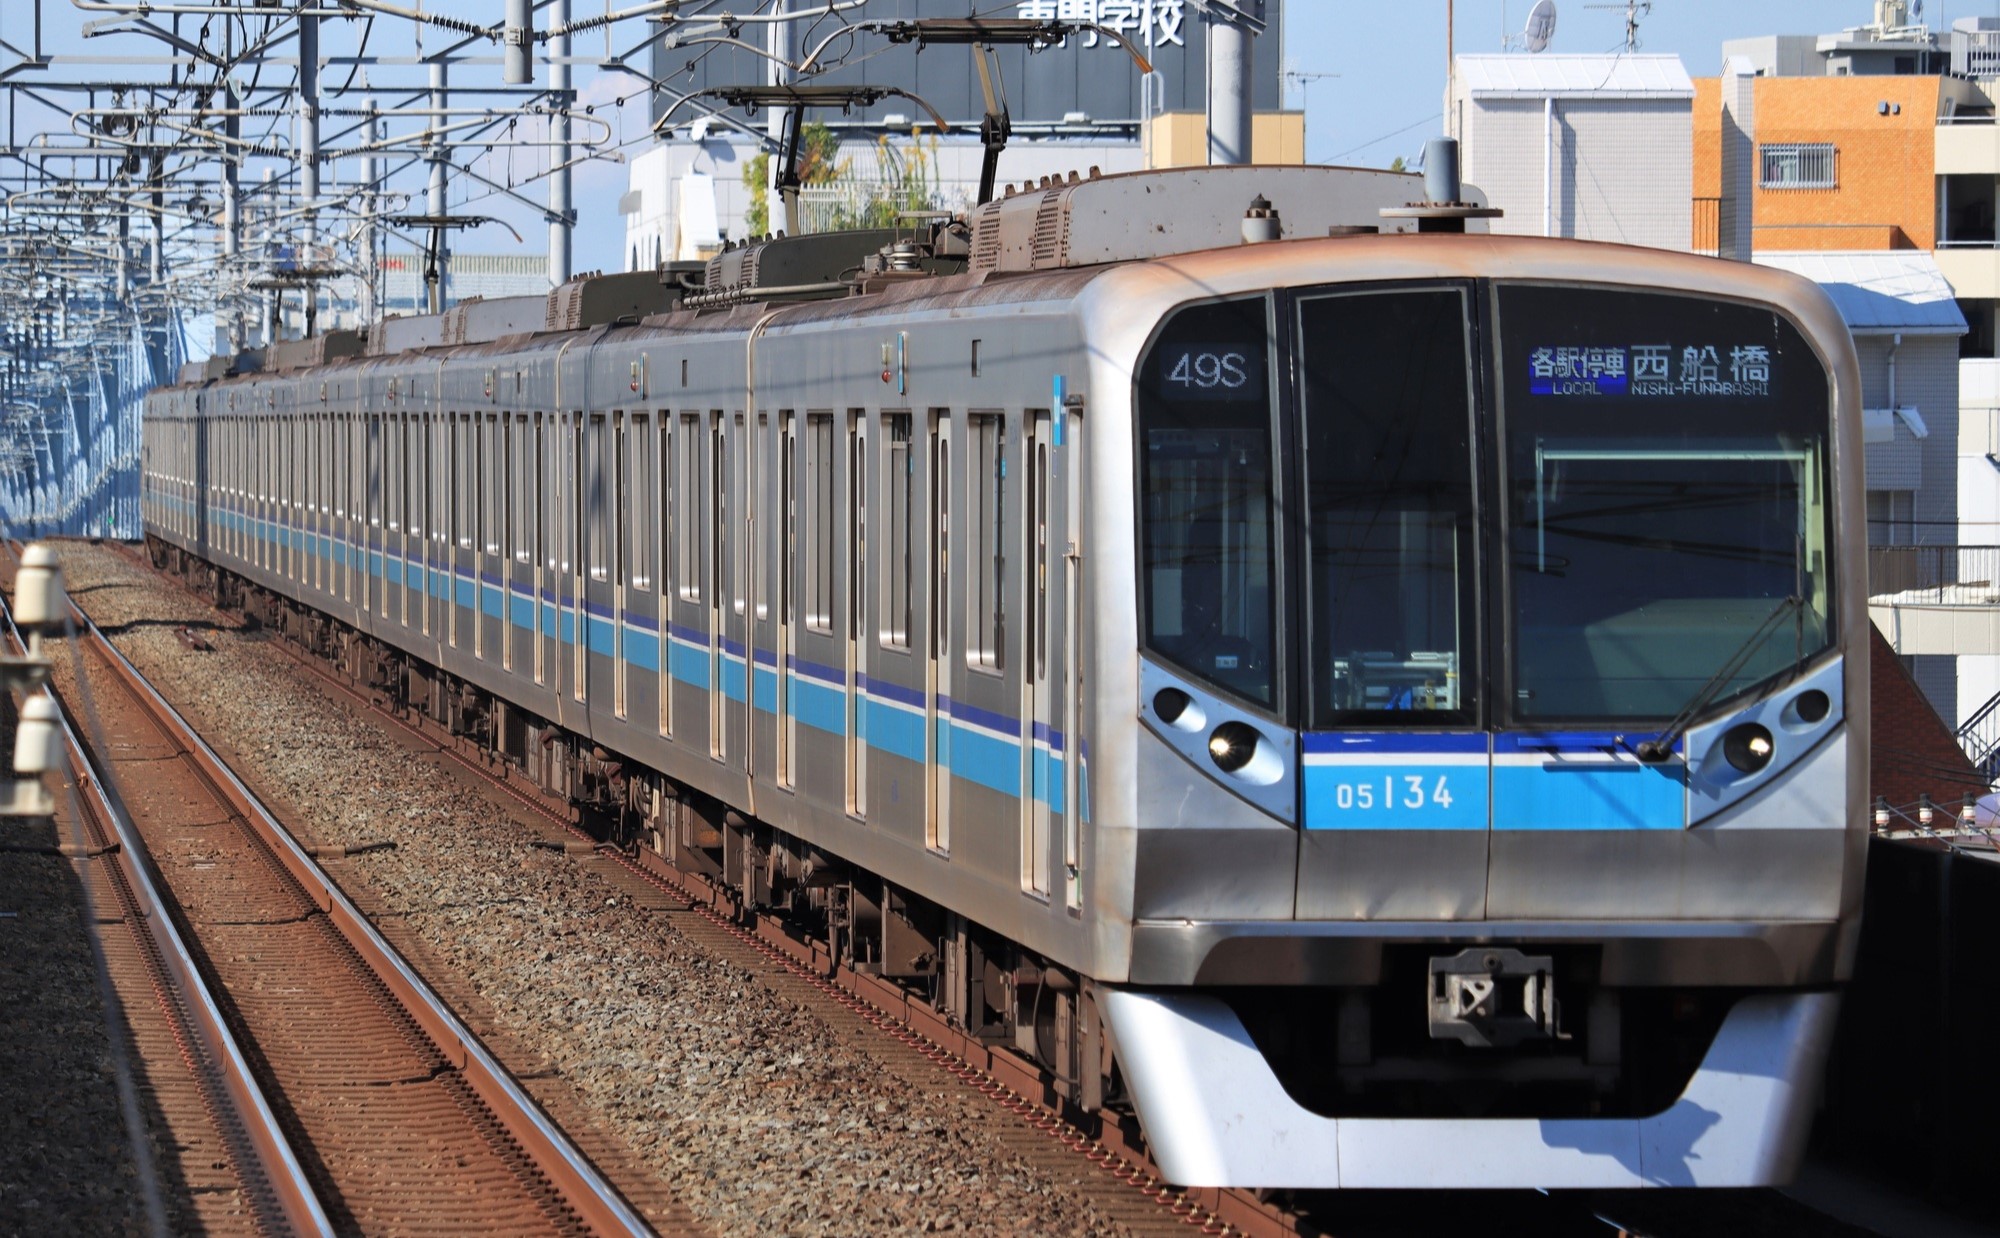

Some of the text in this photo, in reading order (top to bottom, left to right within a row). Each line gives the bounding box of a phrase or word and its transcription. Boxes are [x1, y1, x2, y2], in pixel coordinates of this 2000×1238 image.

[1168, 352, 1247, 388] 49S
[1531, 346, 1626, 378] 各駅停車
[1631, 345, 1769, 382] 西船橋
[1553, 381, 1602, 396] LOCAL
[1631, 381, 1769, 396] NISHI-FUNABASHI
